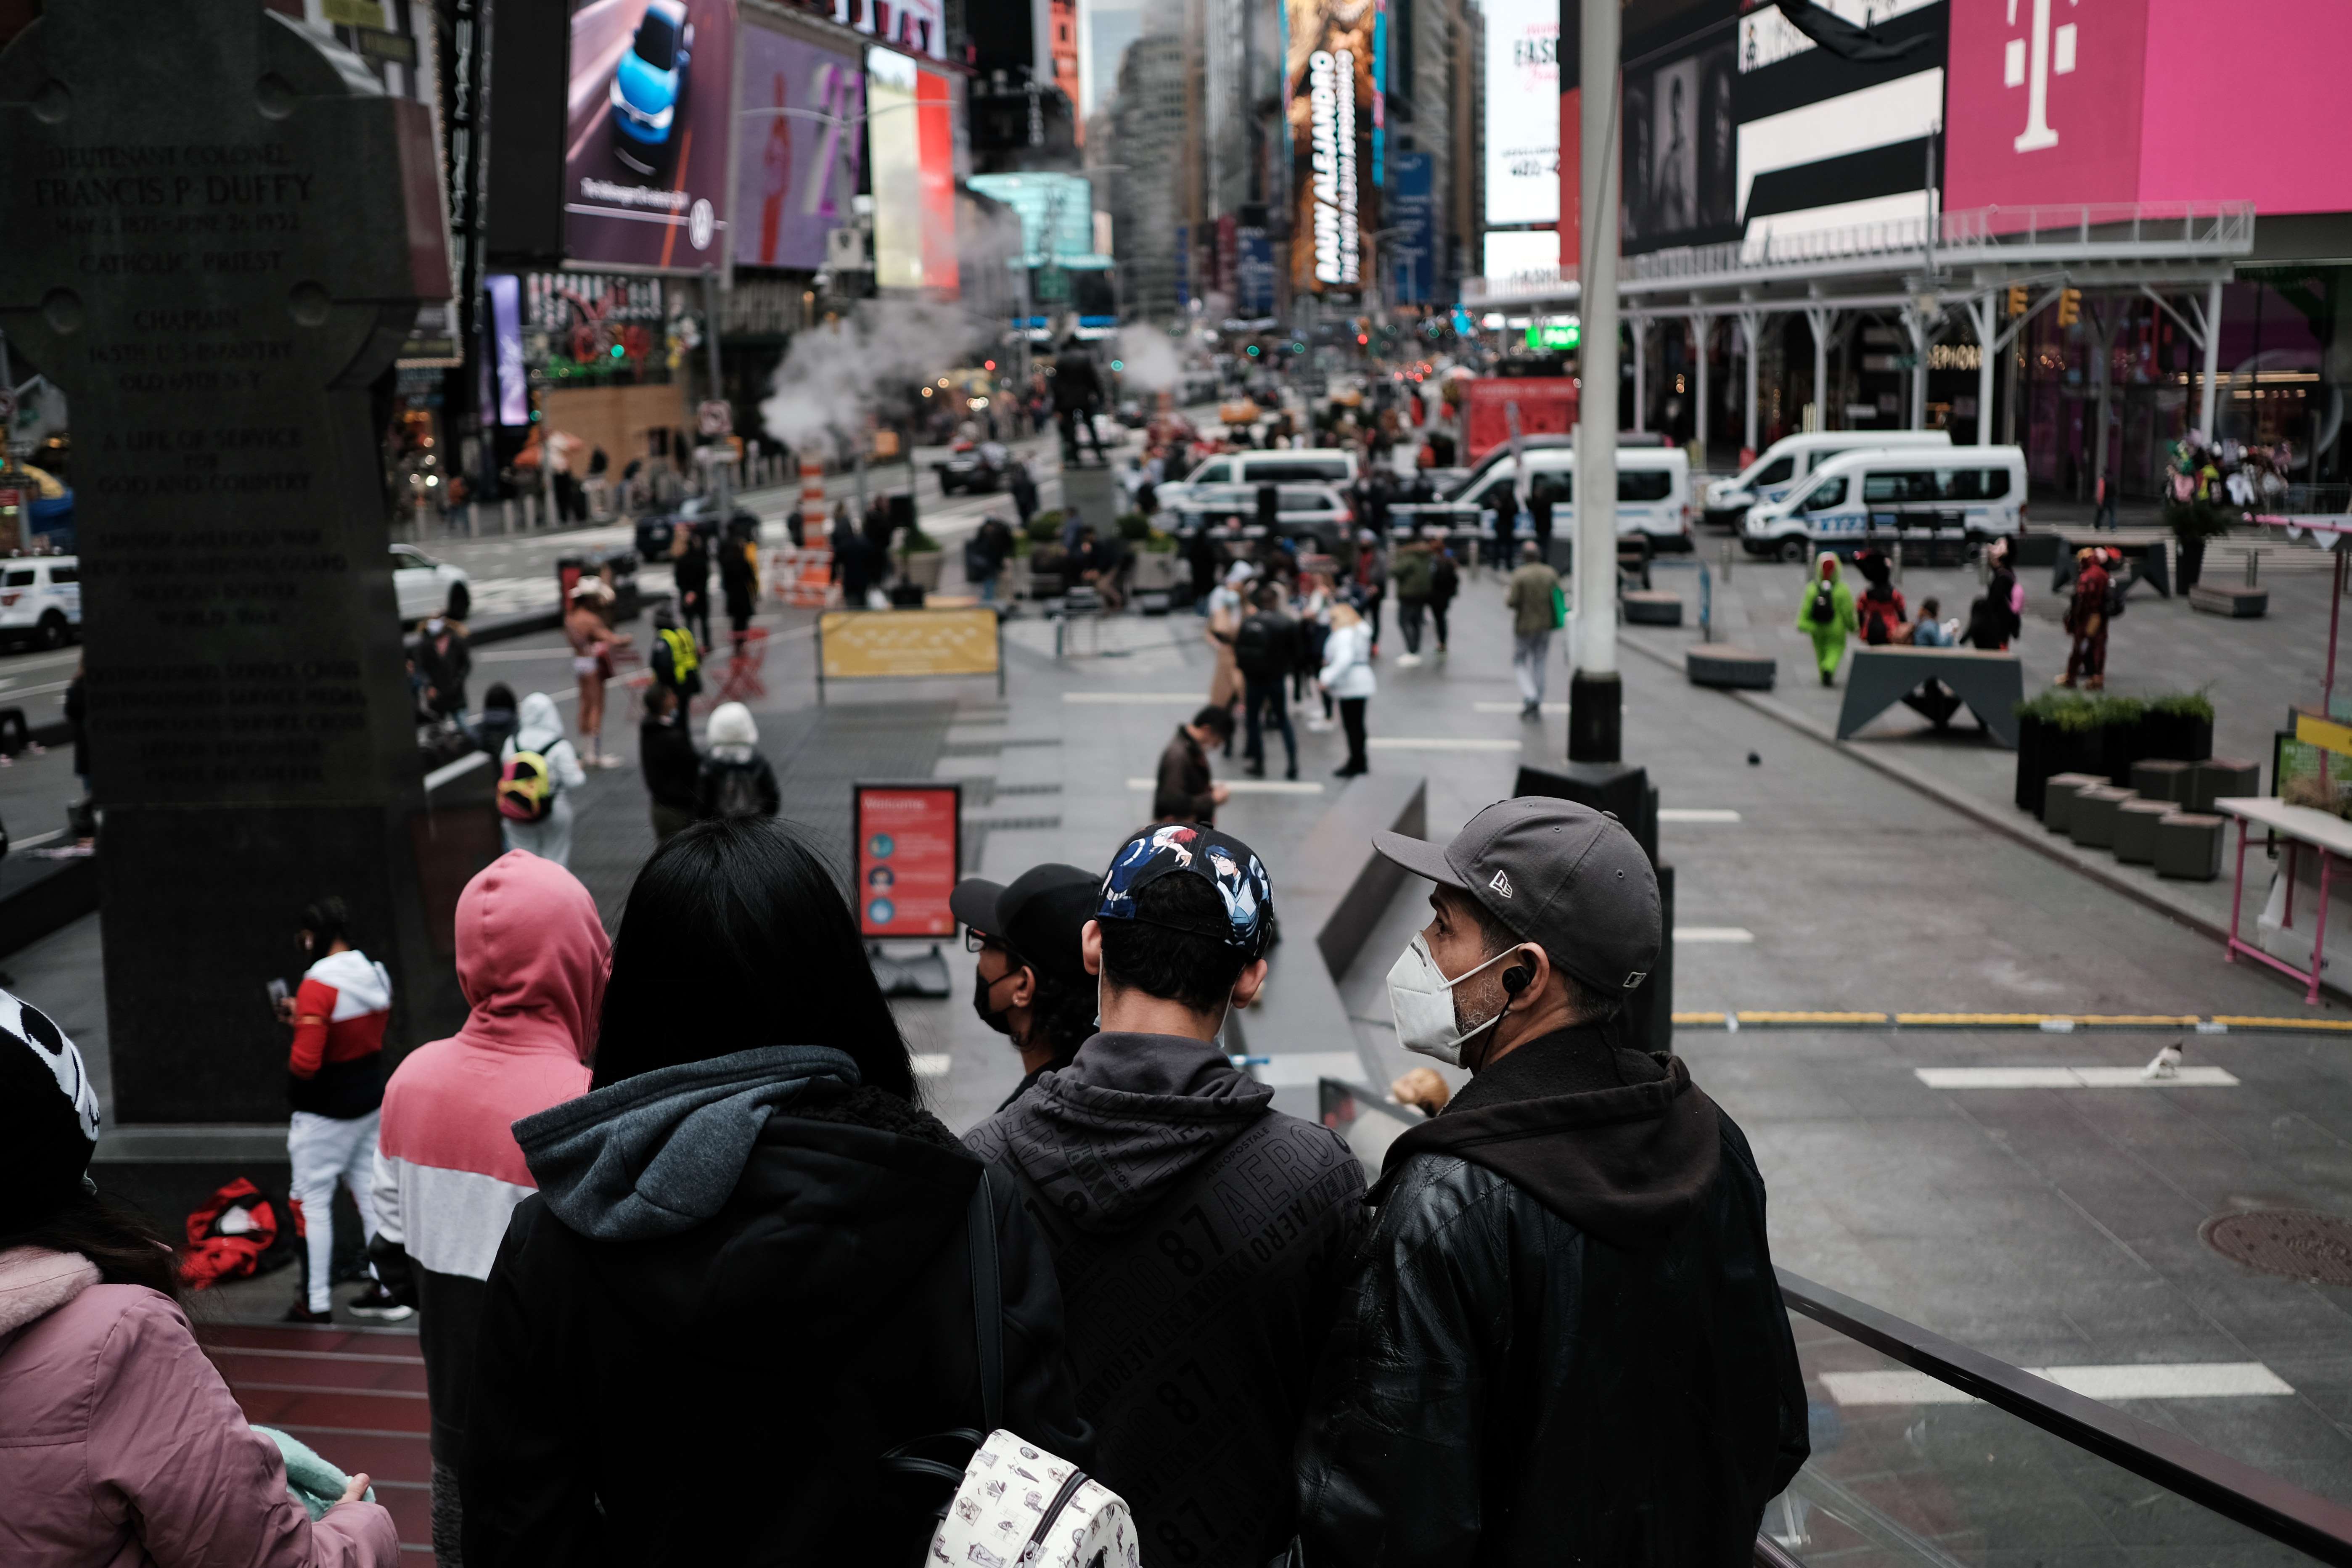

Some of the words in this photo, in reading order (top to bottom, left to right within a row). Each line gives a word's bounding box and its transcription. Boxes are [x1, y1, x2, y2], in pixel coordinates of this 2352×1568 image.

[1310, 50, 1339, 206] ALEJANDRO
[48, 145, 177, 169] LIEUTENANT
[184, 143, 291, 166] COLONEL
[34, 177, 164, 207] FRANCIS
[206, 173, 313, 204] DUFFY
[78, 252, 191, 276] CATHOLIC
[202, 250, 283, 274] PRIEST
[126, 429, 171, 451] LIFE
[213, 426, 304, 450] SERVICE
[209, 470, 312, 493] COUNTRY
[1204, 1126, 1270, 1181] AEROPOSTALE
[1074, 1255, 1175, 1370] AERO
[1157, 1203, 1225, 1277] 87
[1212, 1124, 1334, 1238] AERO
[1250, 1198, 1309, 1262] AERO
[1156, 1357, 1219, 1425] 87
[1156, 1496, 1219, 1565] 87
